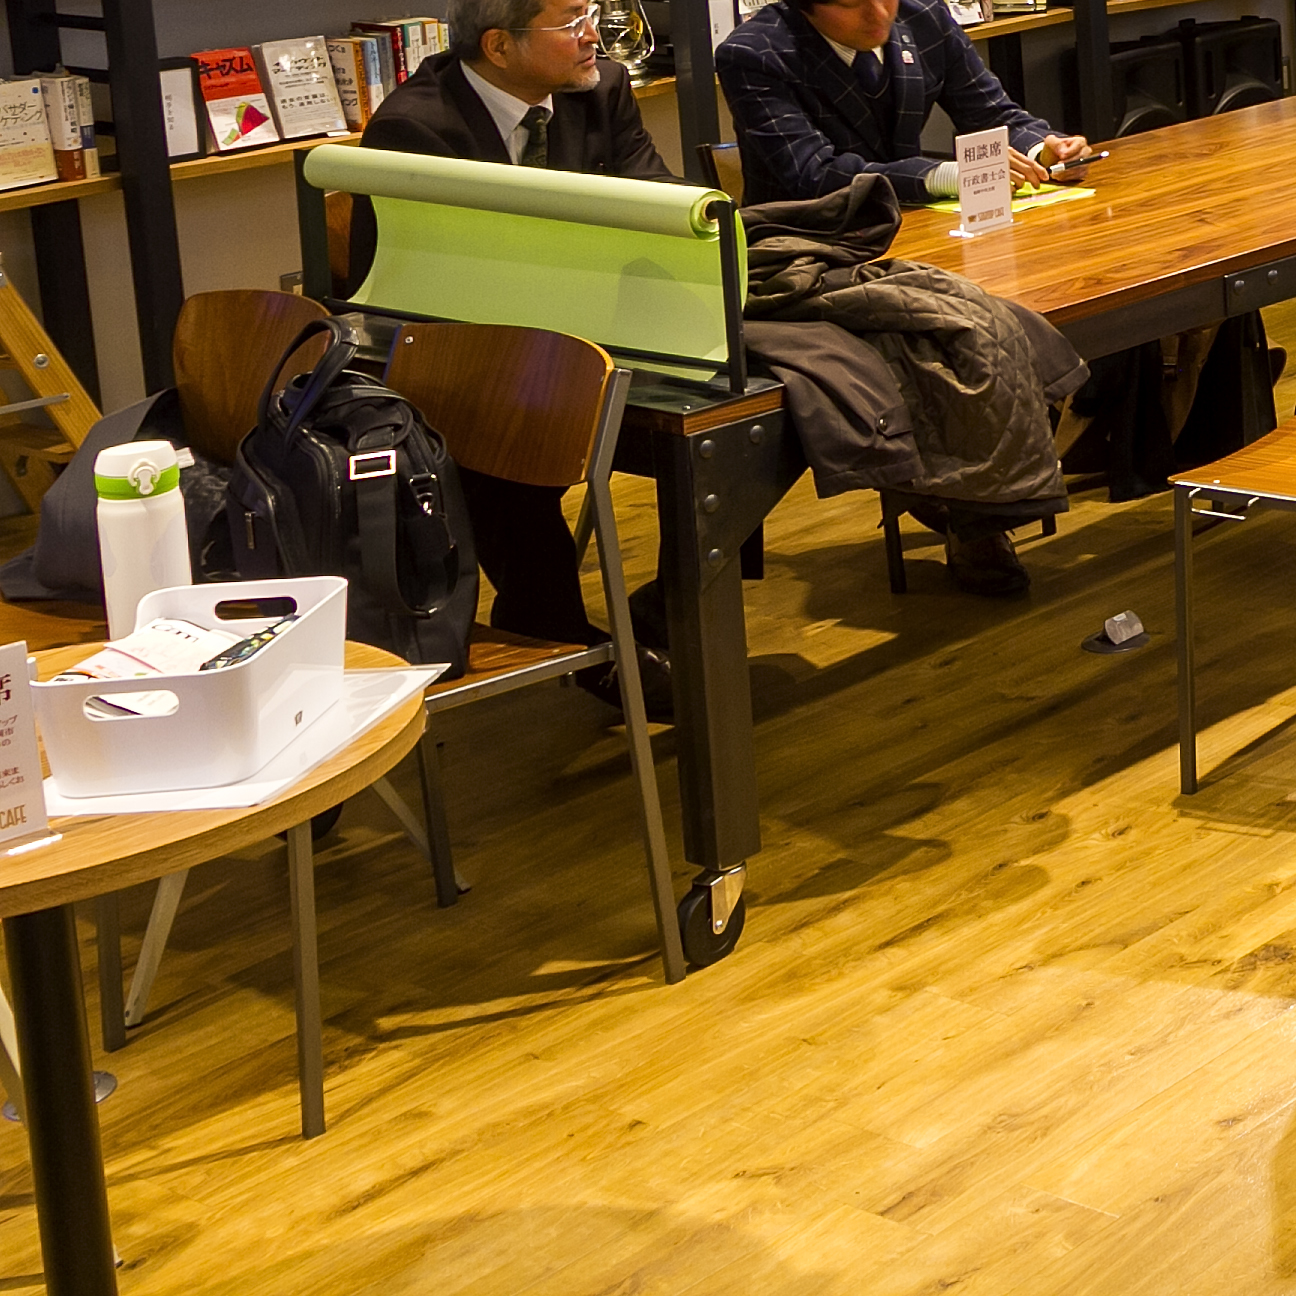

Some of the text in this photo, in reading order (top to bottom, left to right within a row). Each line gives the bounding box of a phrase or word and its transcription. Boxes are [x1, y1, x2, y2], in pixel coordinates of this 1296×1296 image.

[200, 56, 254, 79] キャズム
[964, 141, 1002, 163] 相談席
[963, 169, 1006, 189] 行政書士会
